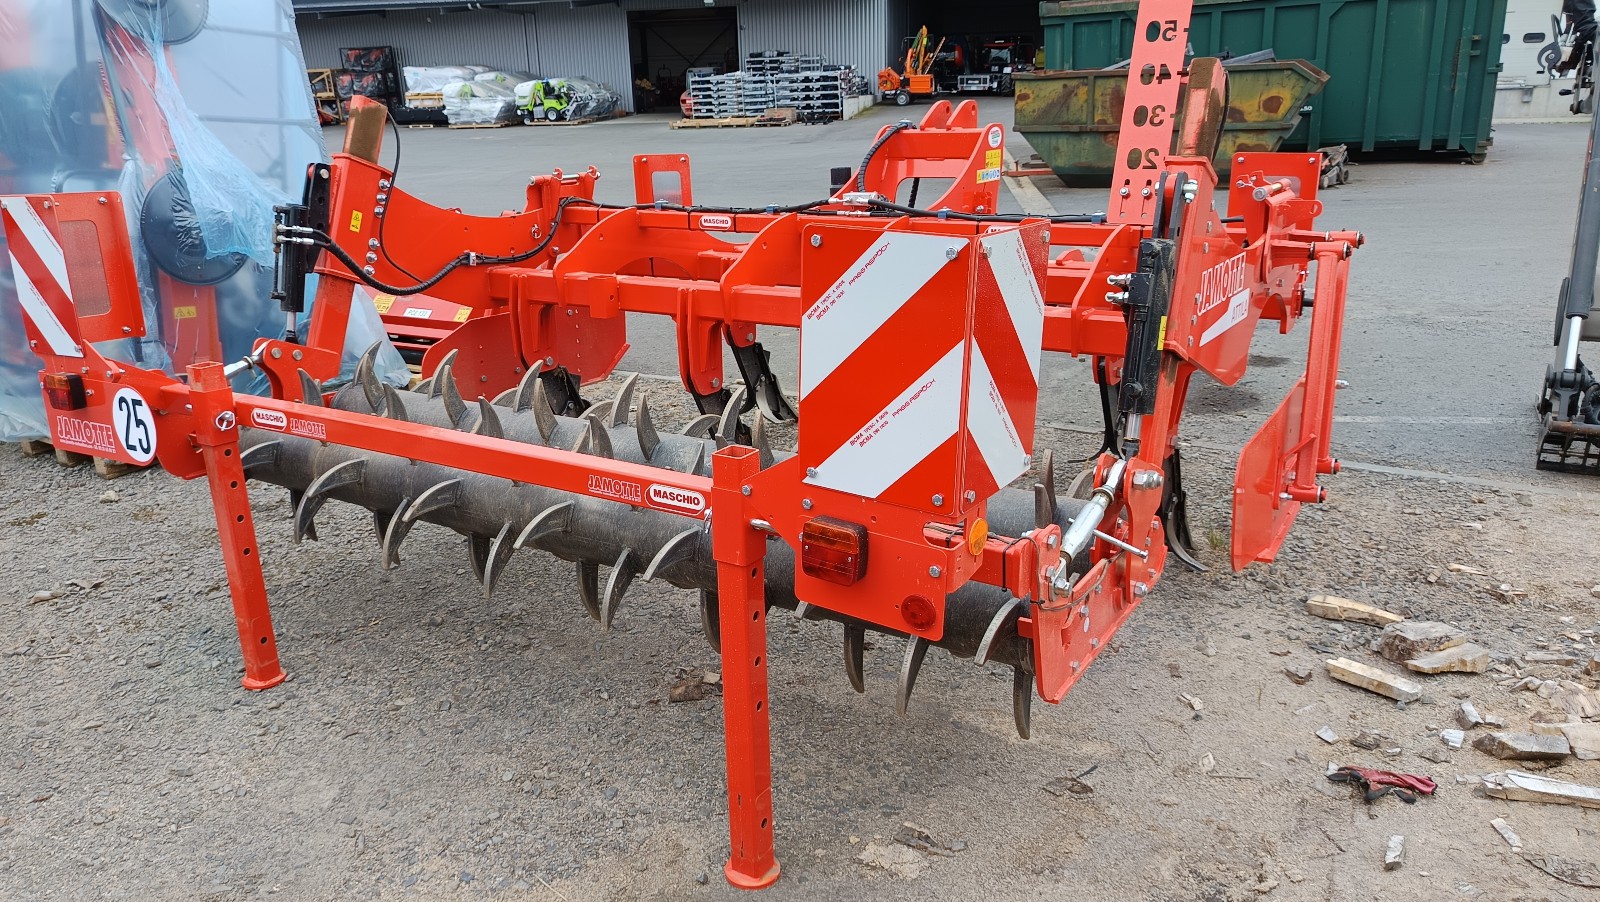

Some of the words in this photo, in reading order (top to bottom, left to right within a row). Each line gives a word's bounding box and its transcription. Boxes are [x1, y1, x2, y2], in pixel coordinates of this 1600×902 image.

[1197, 251, 1247, 317] JAMOTTE
[118, 395, 152, 455] 25
[255, 411, 284, 424] MASCHIO
[290, 418, 326, 436] JAMOTTE
[57, 414, 116, 448] JAMOTTE
[588, 474, 642, 499] JAMOTTE
[653, 488, 701, 507] MASCHIO
